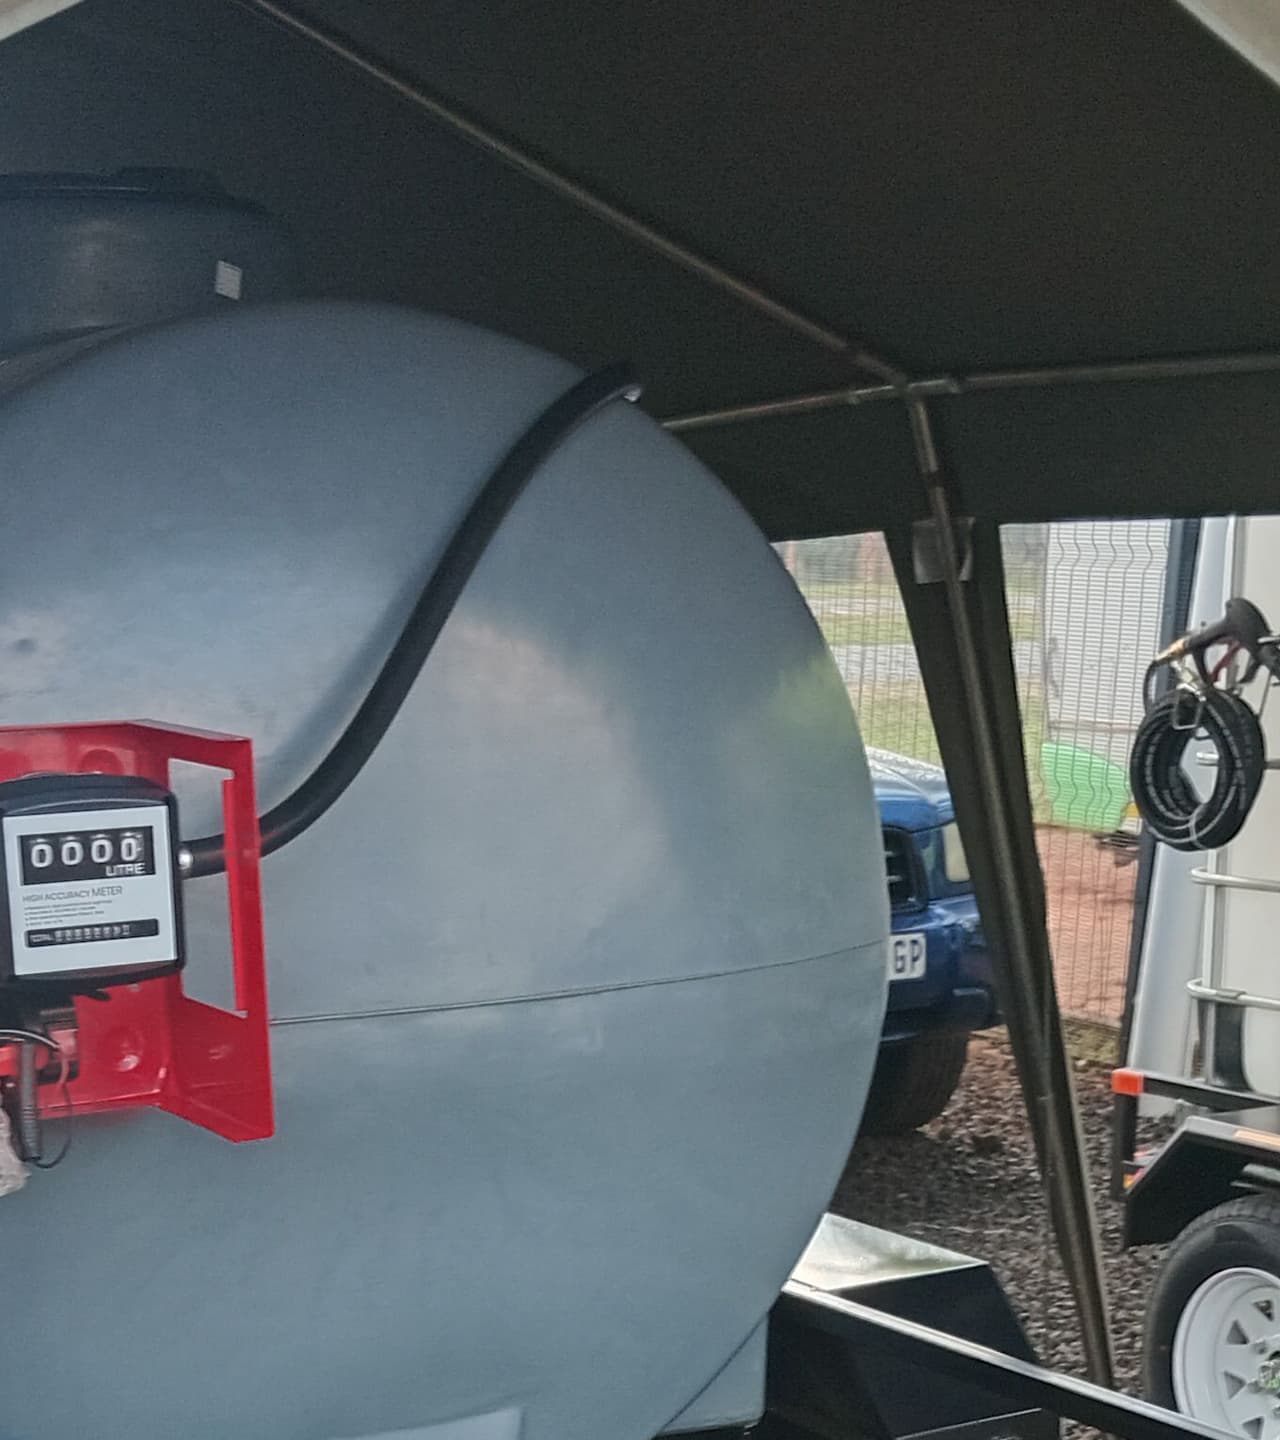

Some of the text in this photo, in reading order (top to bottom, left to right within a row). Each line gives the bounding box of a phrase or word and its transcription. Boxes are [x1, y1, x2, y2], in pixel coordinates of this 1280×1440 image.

[105, 862, 146, 876] LITRE
[23, 885, 123, 902] HIGH ACCURACY METER
[894, 939, 924, 974] GP
